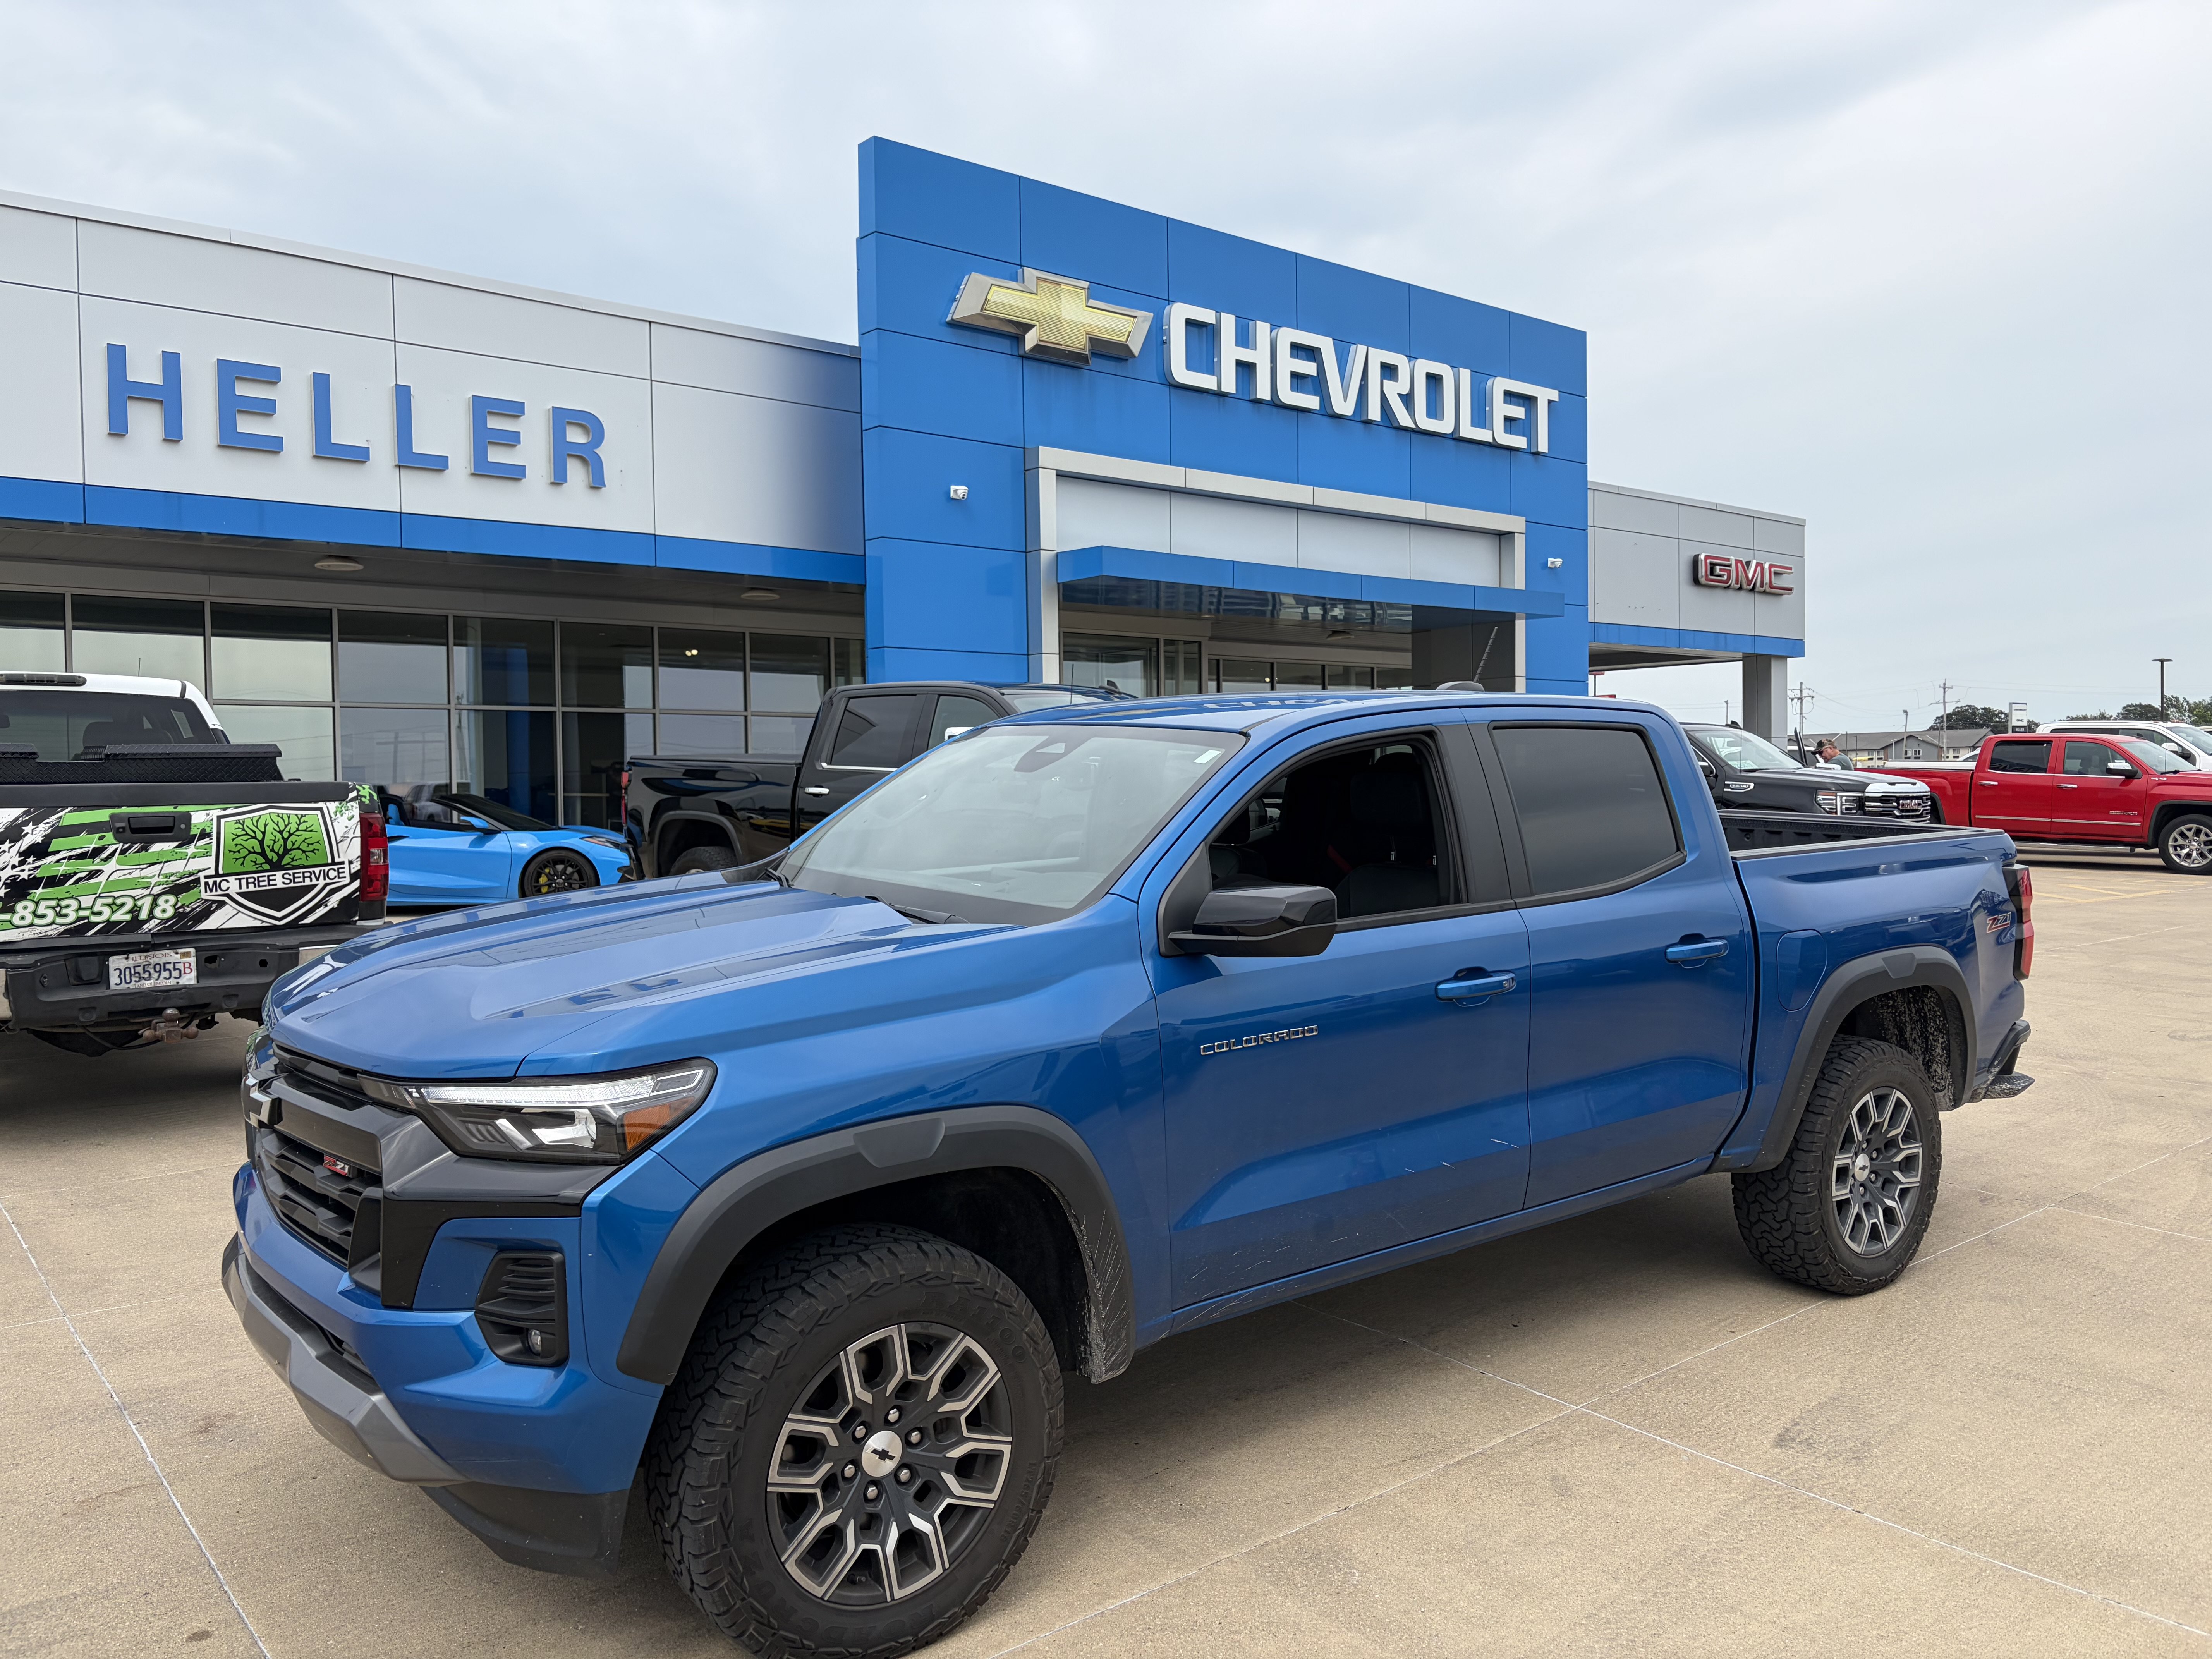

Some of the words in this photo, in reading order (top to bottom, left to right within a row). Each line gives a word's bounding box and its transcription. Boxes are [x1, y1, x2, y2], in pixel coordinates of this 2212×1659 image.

[1163, 302, 1559, 453] CHEVROLET
[106, 343, 606, 488] HELLER
[1693, 553, 1794, 595] GMC
[1899, 800, 1922, 809] GMC
[204, 880, 230, 893] MC
[235, 874, 277, 890] TREE
[282, 867, 346, 885] SERVICE
[1986, 912, 2011, 933] Z71
[132, 952, 172, 961] ILLINOIS
[1200, 1025, 1318, 1055] COLORADO
[323, 1155, 350, 1176] Z71
